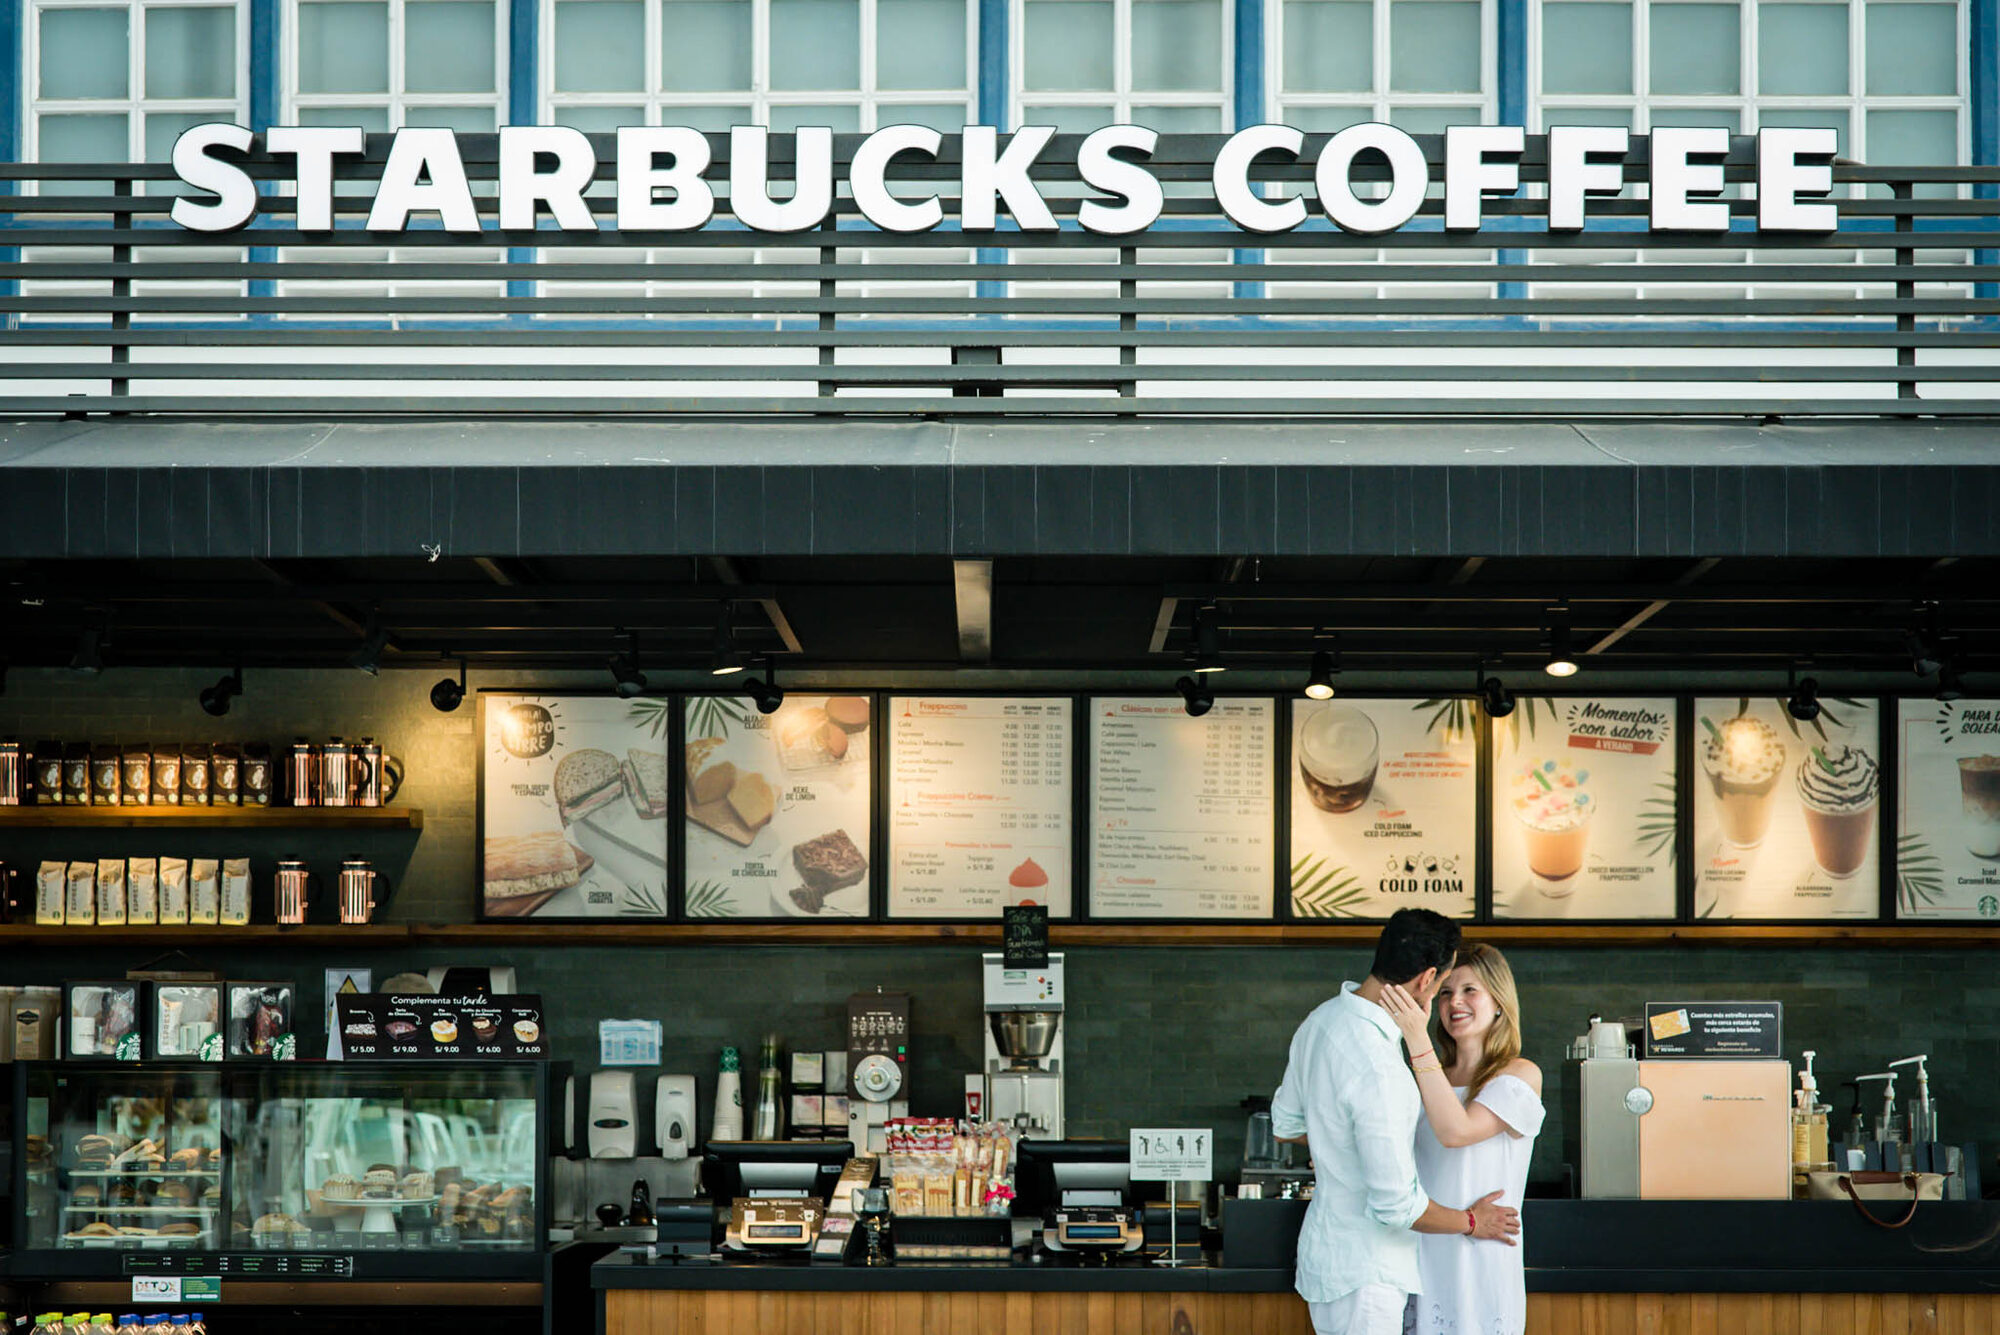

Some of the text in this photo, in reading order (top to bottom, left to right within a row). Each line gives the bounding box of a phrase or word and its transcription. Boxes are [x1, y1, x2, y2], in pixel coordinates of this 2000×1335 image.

[170, 122, 1839, 236] STARBUCKS COFFEE
[1580, 702, 1660, 726] Momentos
[1960, 710, 1991, 722] PARA
[1577, 721, 1656, 740] con sabor
[1602, 740, 1634, 751] VERANO
[1374, 822, 1412, 830] COLD FOAM
[1982, 868, 1997, 876] Iced
[1378, 877, 1464, 894] COLD FOAM
[391, 994, 489, 1006] Complementa tu tarde
[350, 1045, 376, 1053] S/ 5.00
[392, 1045, 418, 1053] S/ 9.00
[434, 1045, 460, 1053] S/ 9.00
[476, 1045, 502, 1053] S/ 6.00
[516, 1045, 541, 1053] S/ 6.00
[135, 1280, 178, 1294] DETOX
